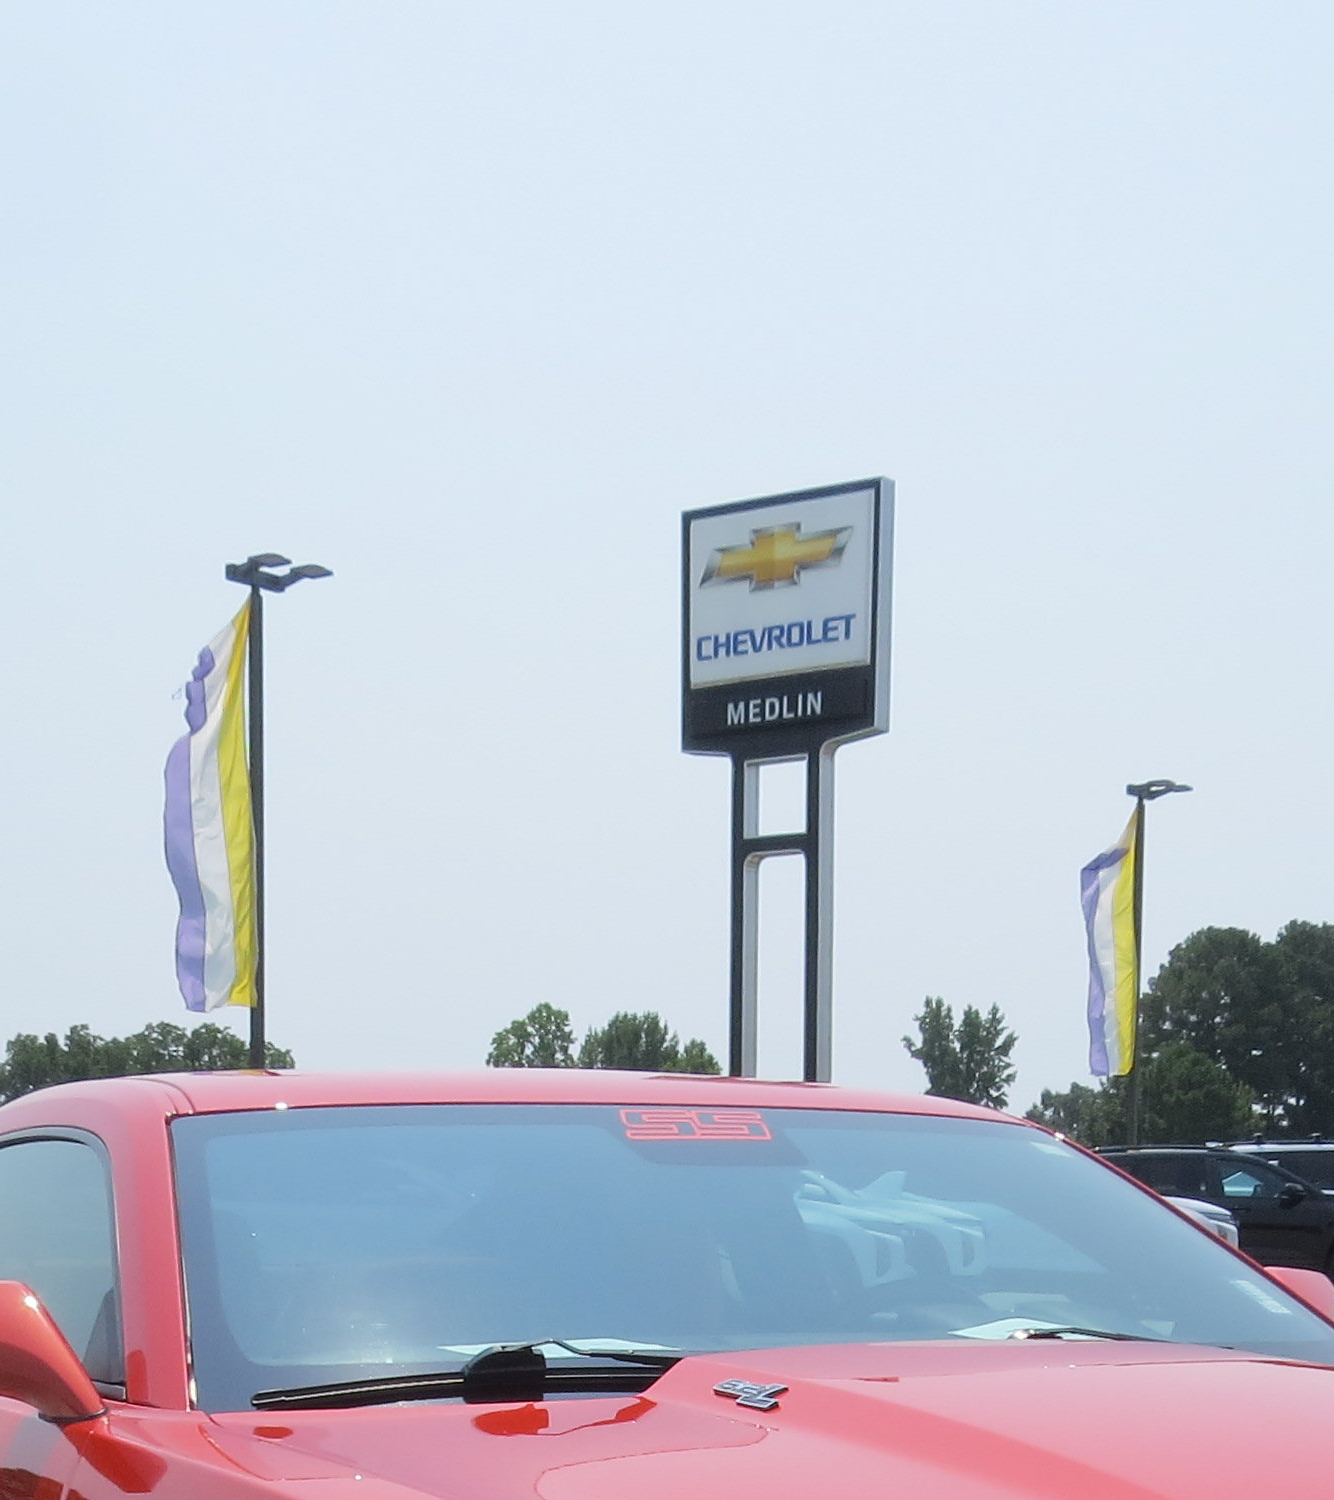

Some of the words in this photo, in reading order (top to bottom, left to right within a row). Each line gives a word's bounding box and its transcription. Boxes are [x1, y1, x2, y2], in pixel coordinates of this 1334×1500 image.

[696, 613, 856, 662] CHEVROLET
[727, 691, 822, 726] MEDLIN
[619, 1108, 771, 1140] SS
